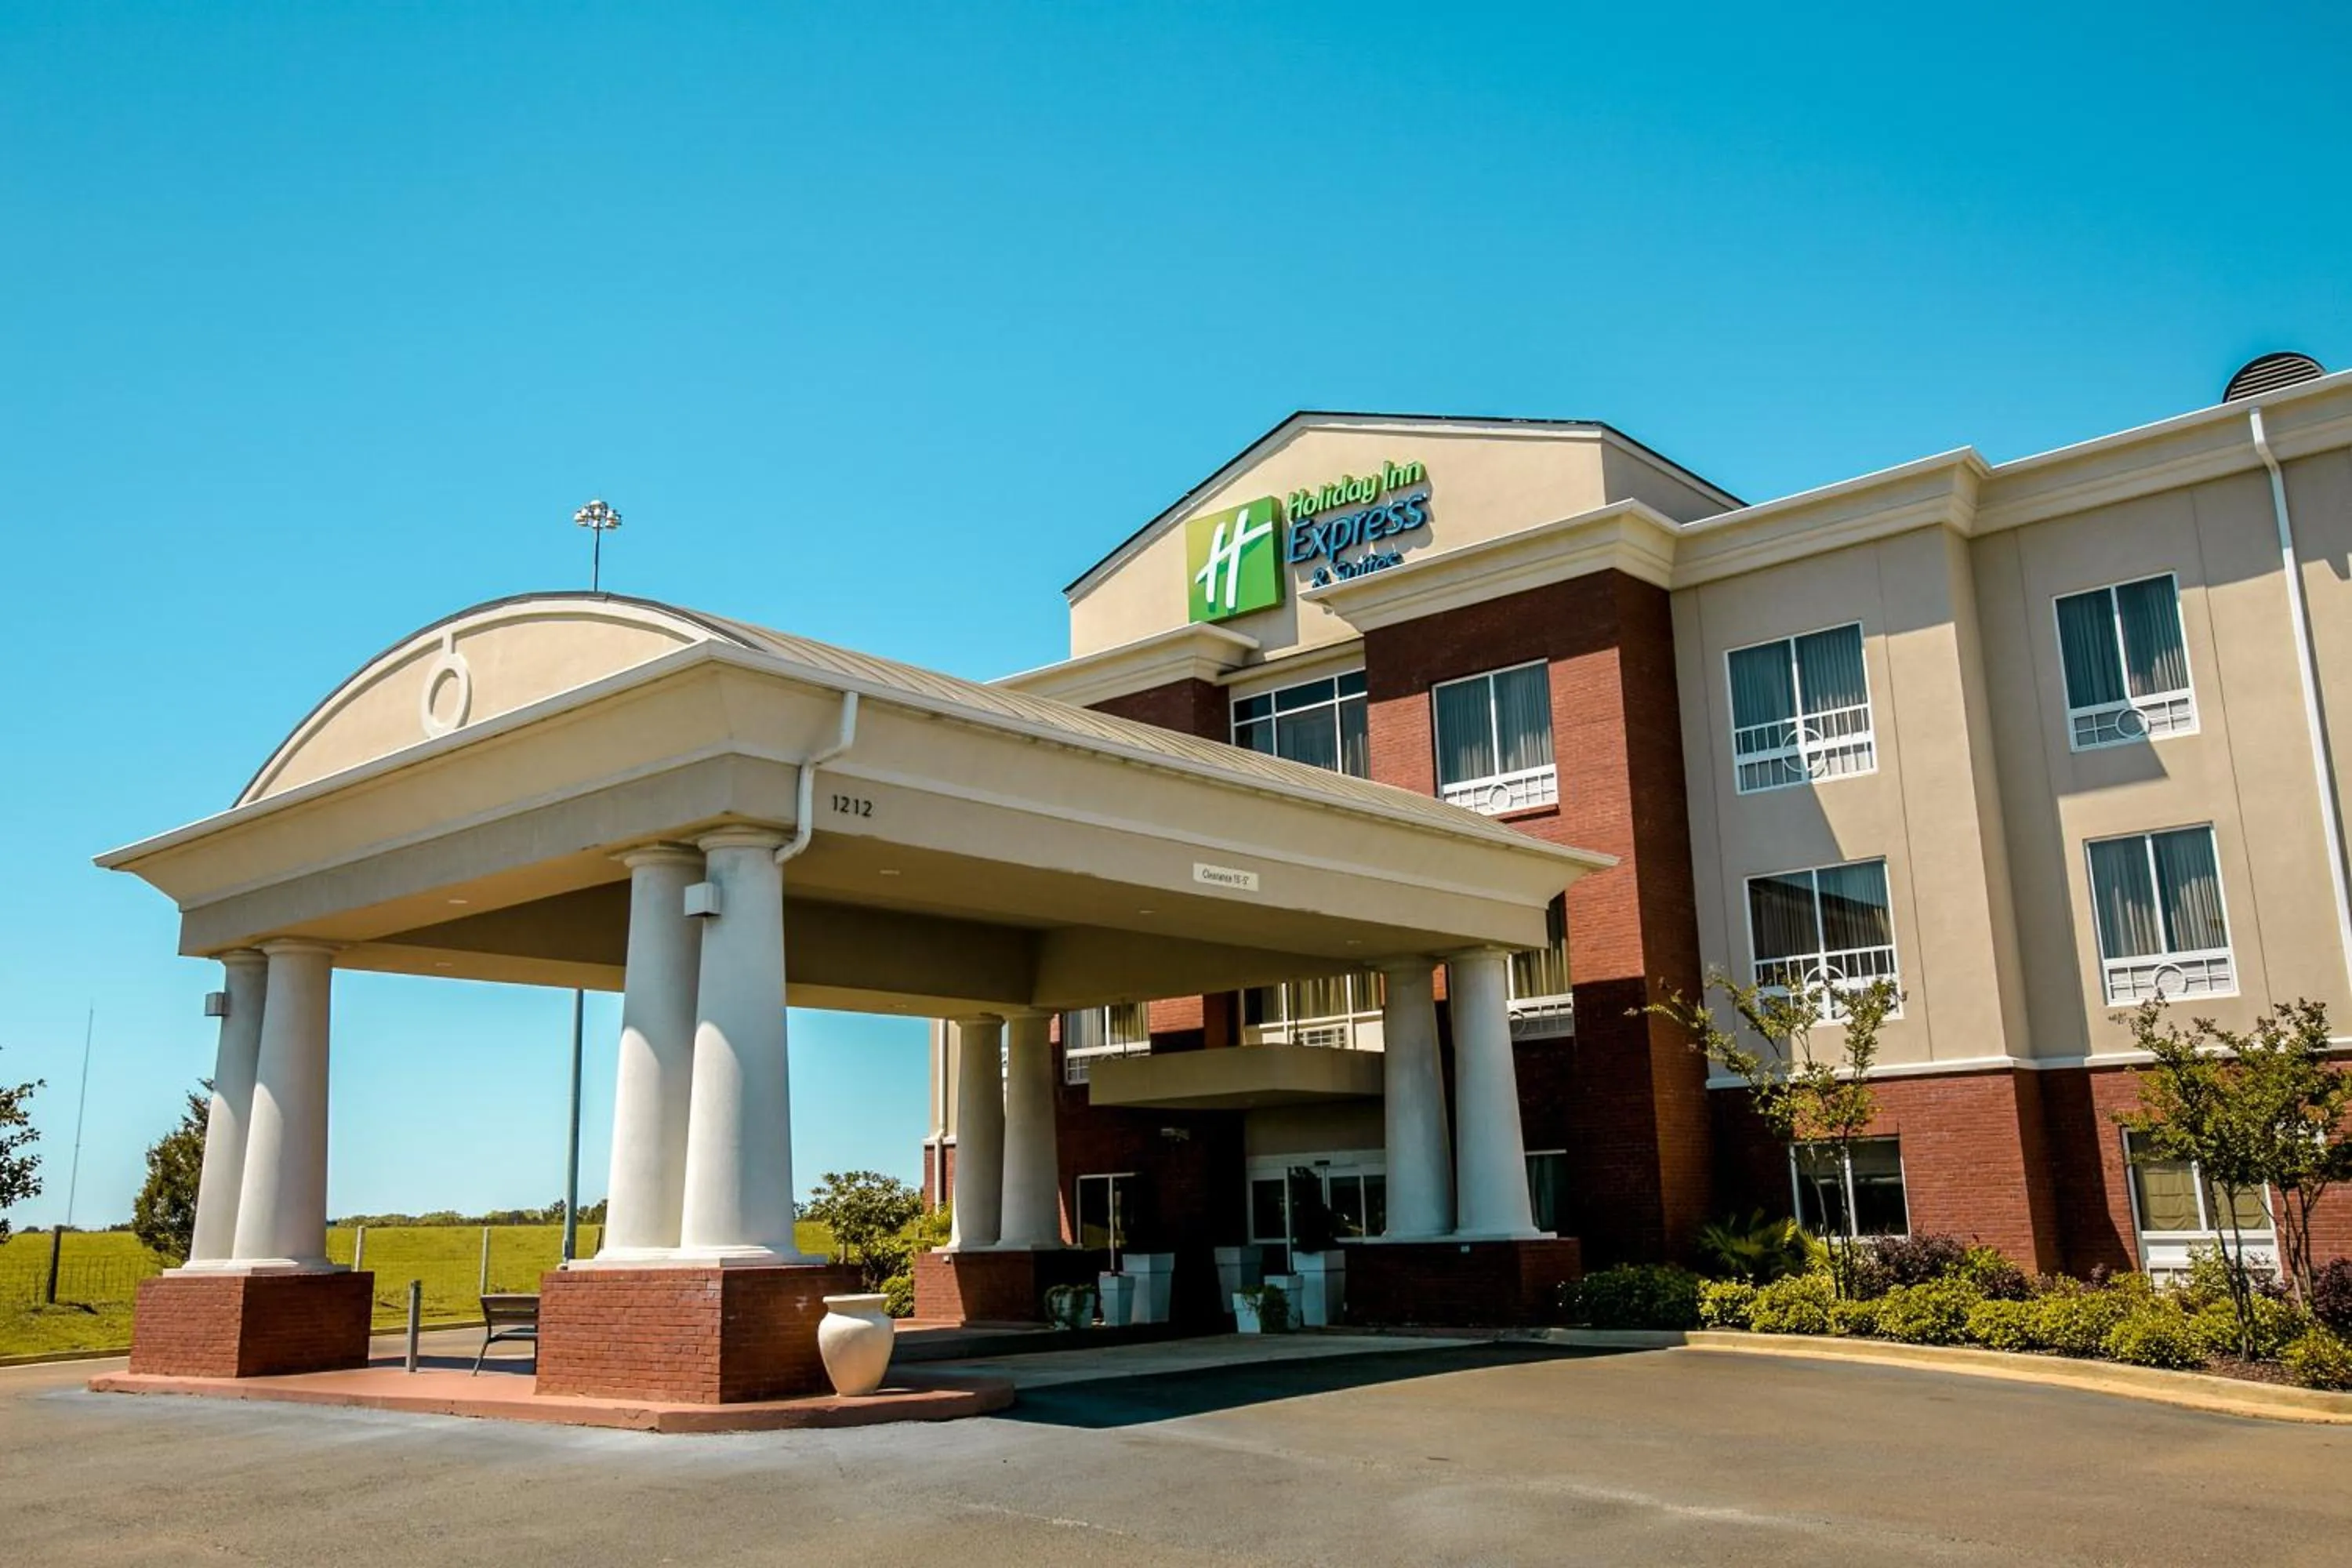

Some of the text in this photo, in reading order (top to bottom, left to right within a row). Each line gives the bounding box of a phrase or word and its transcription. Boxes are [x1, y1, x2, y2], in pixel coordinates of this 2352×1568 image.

[1287, 460, 1425, 521] Holiday Inn
[1287, 495, 1428, 564] Express
[1312, 567, 1331, 588] &
[832, 794, 873, 818] 1212
